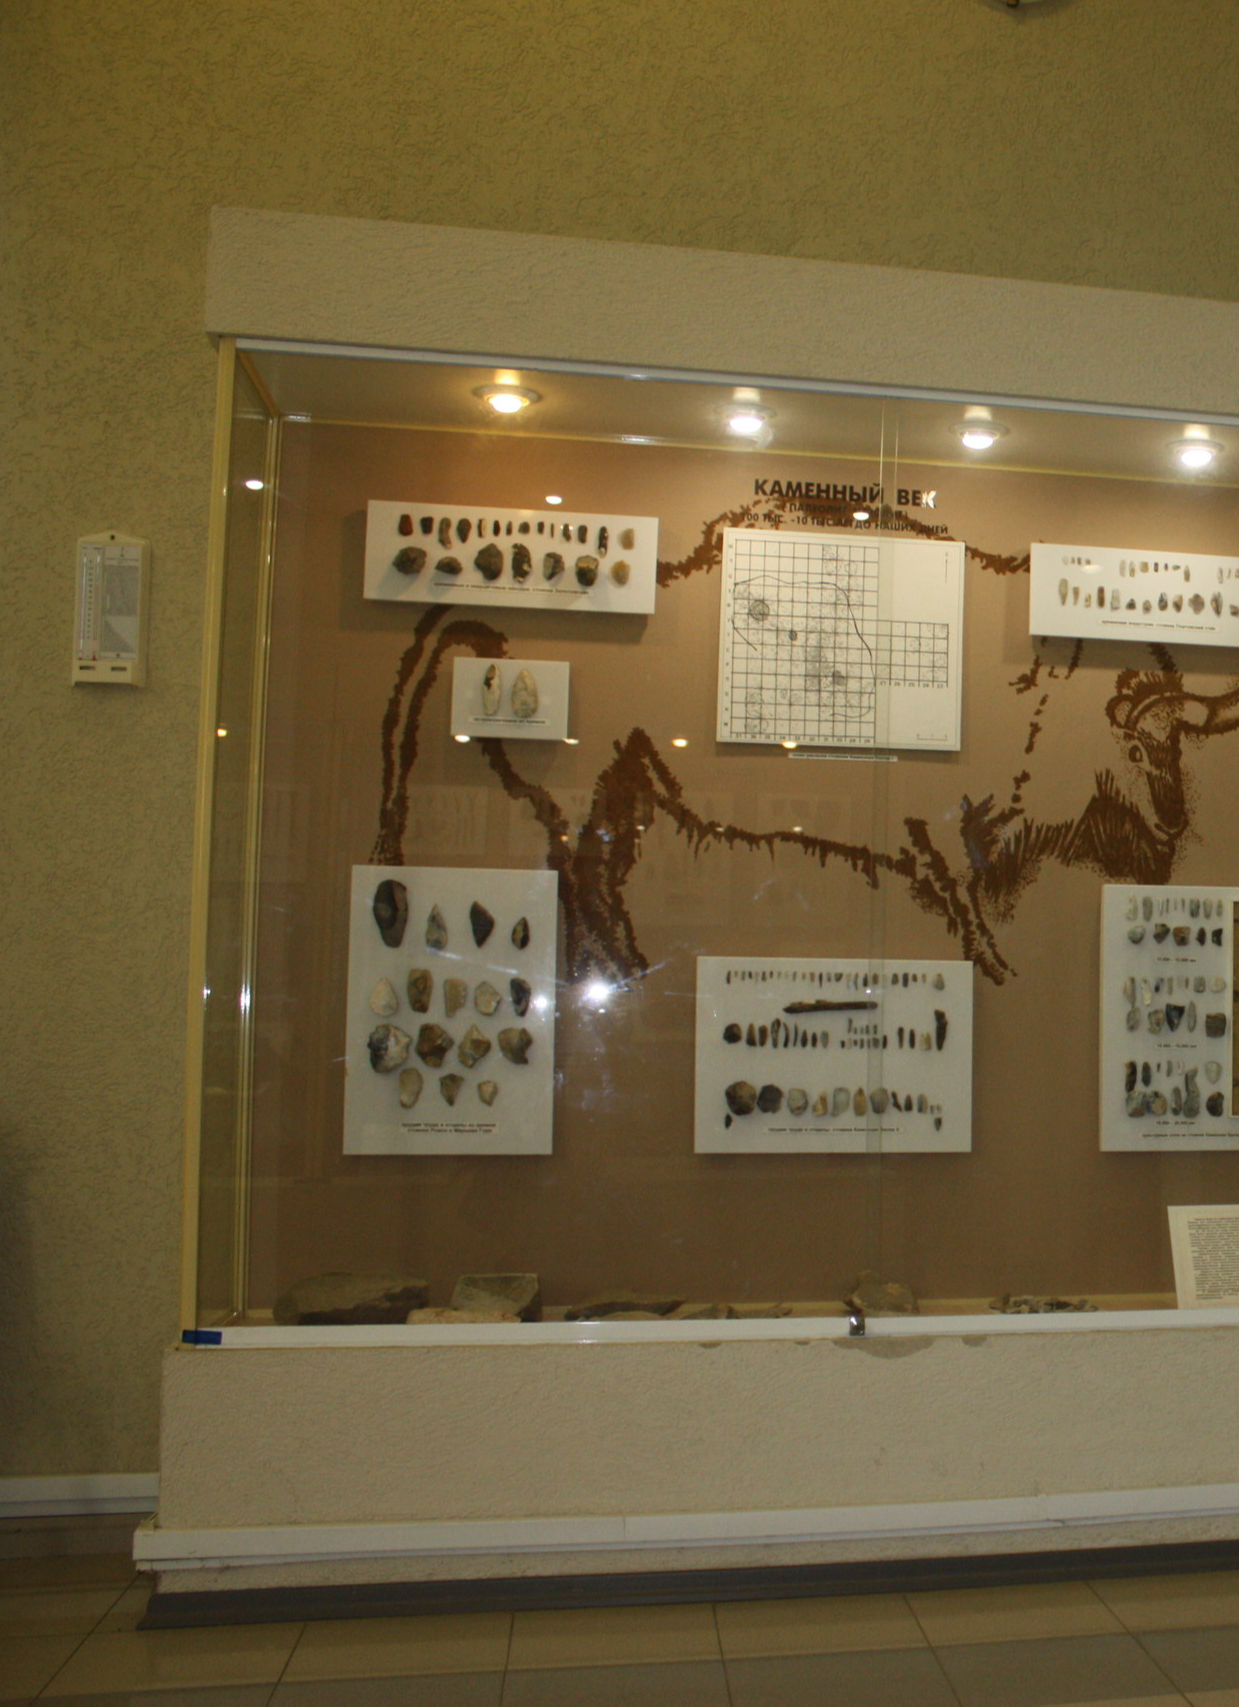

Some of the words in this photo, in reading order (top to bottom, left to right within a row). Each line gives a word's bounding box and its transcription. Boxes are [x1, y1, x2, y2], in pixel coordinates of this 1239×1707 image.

[754, 478, 884, 504] КАМЕННЫЙ
[897, 488, 937, 509] ВЕК
[854, 519, 872, 531] ДО
